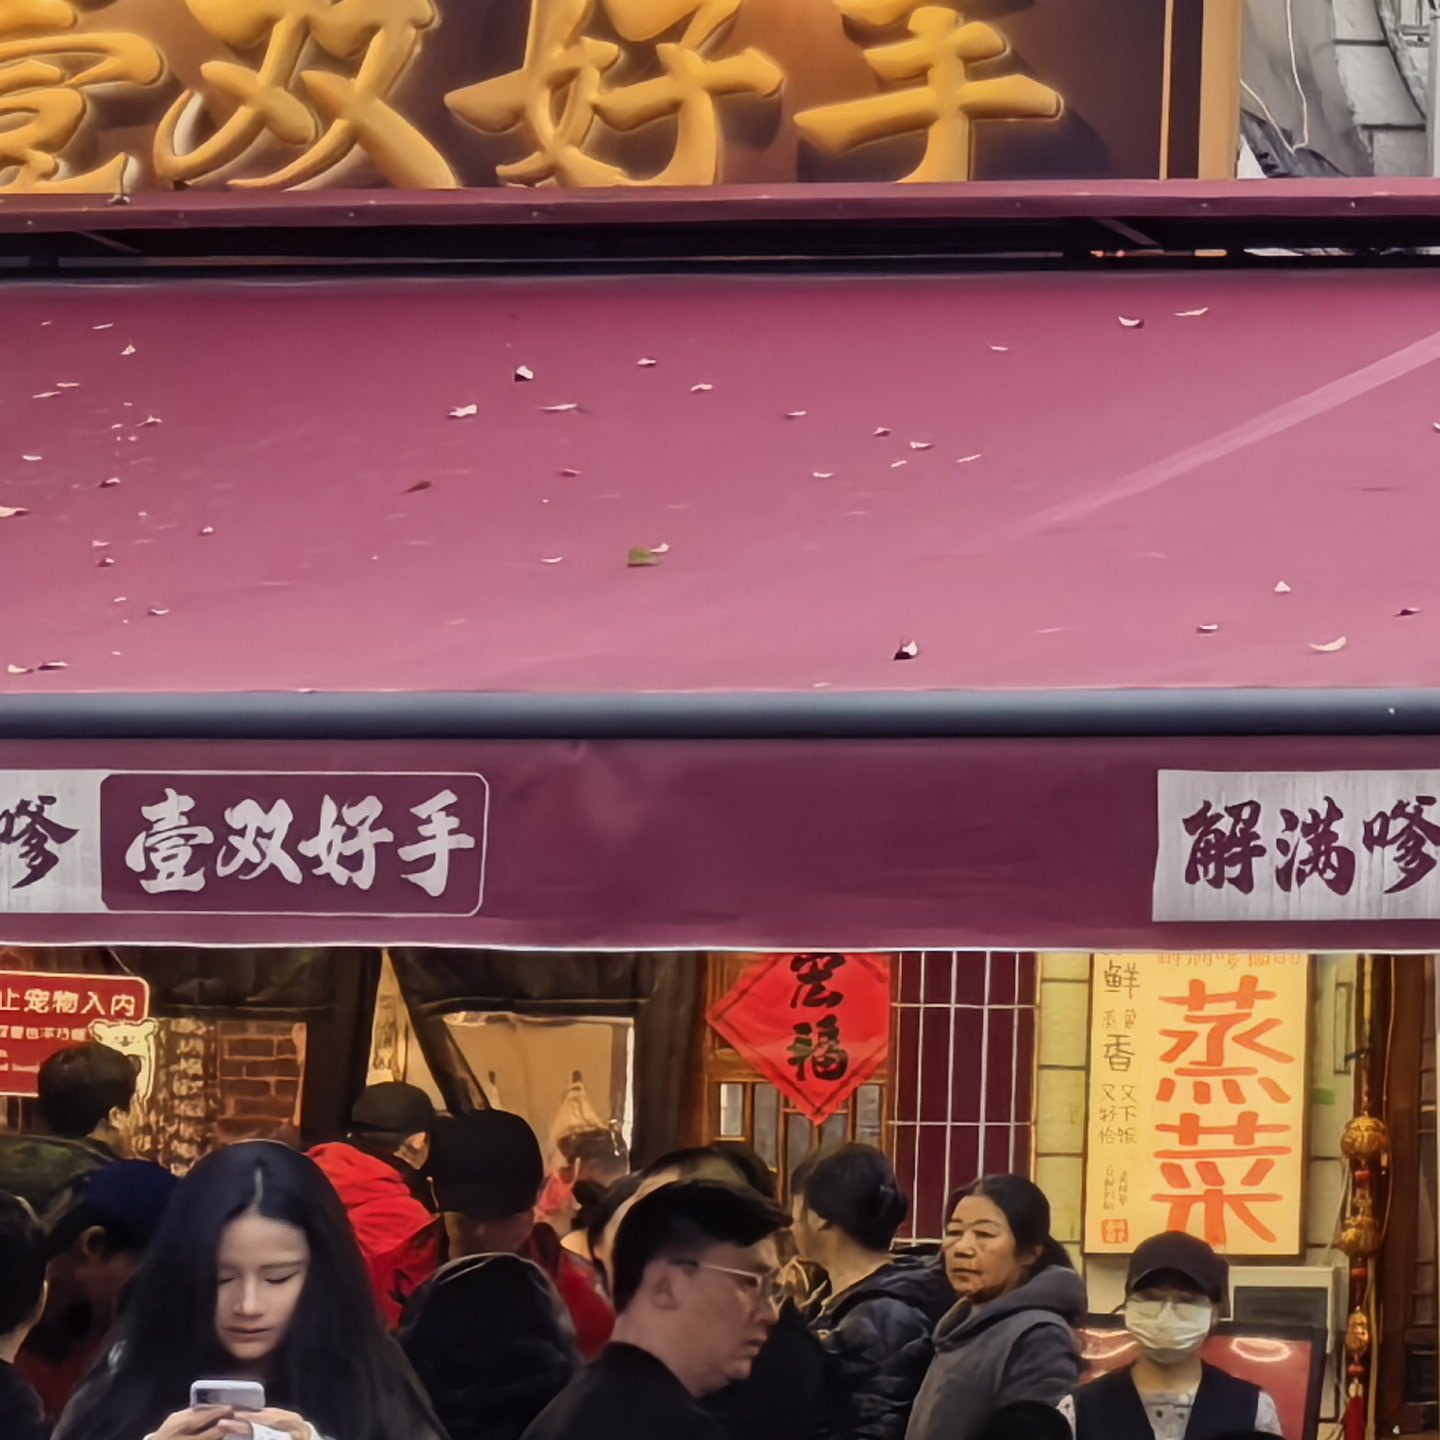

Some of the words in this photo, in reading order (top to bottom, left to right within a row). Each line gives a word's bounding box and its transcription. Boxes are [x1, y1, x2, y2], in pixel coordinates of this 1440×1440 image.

[125, 786, 475, 898] 壹双好手
[1150, 974, 1296, 1248] 蒸菜
